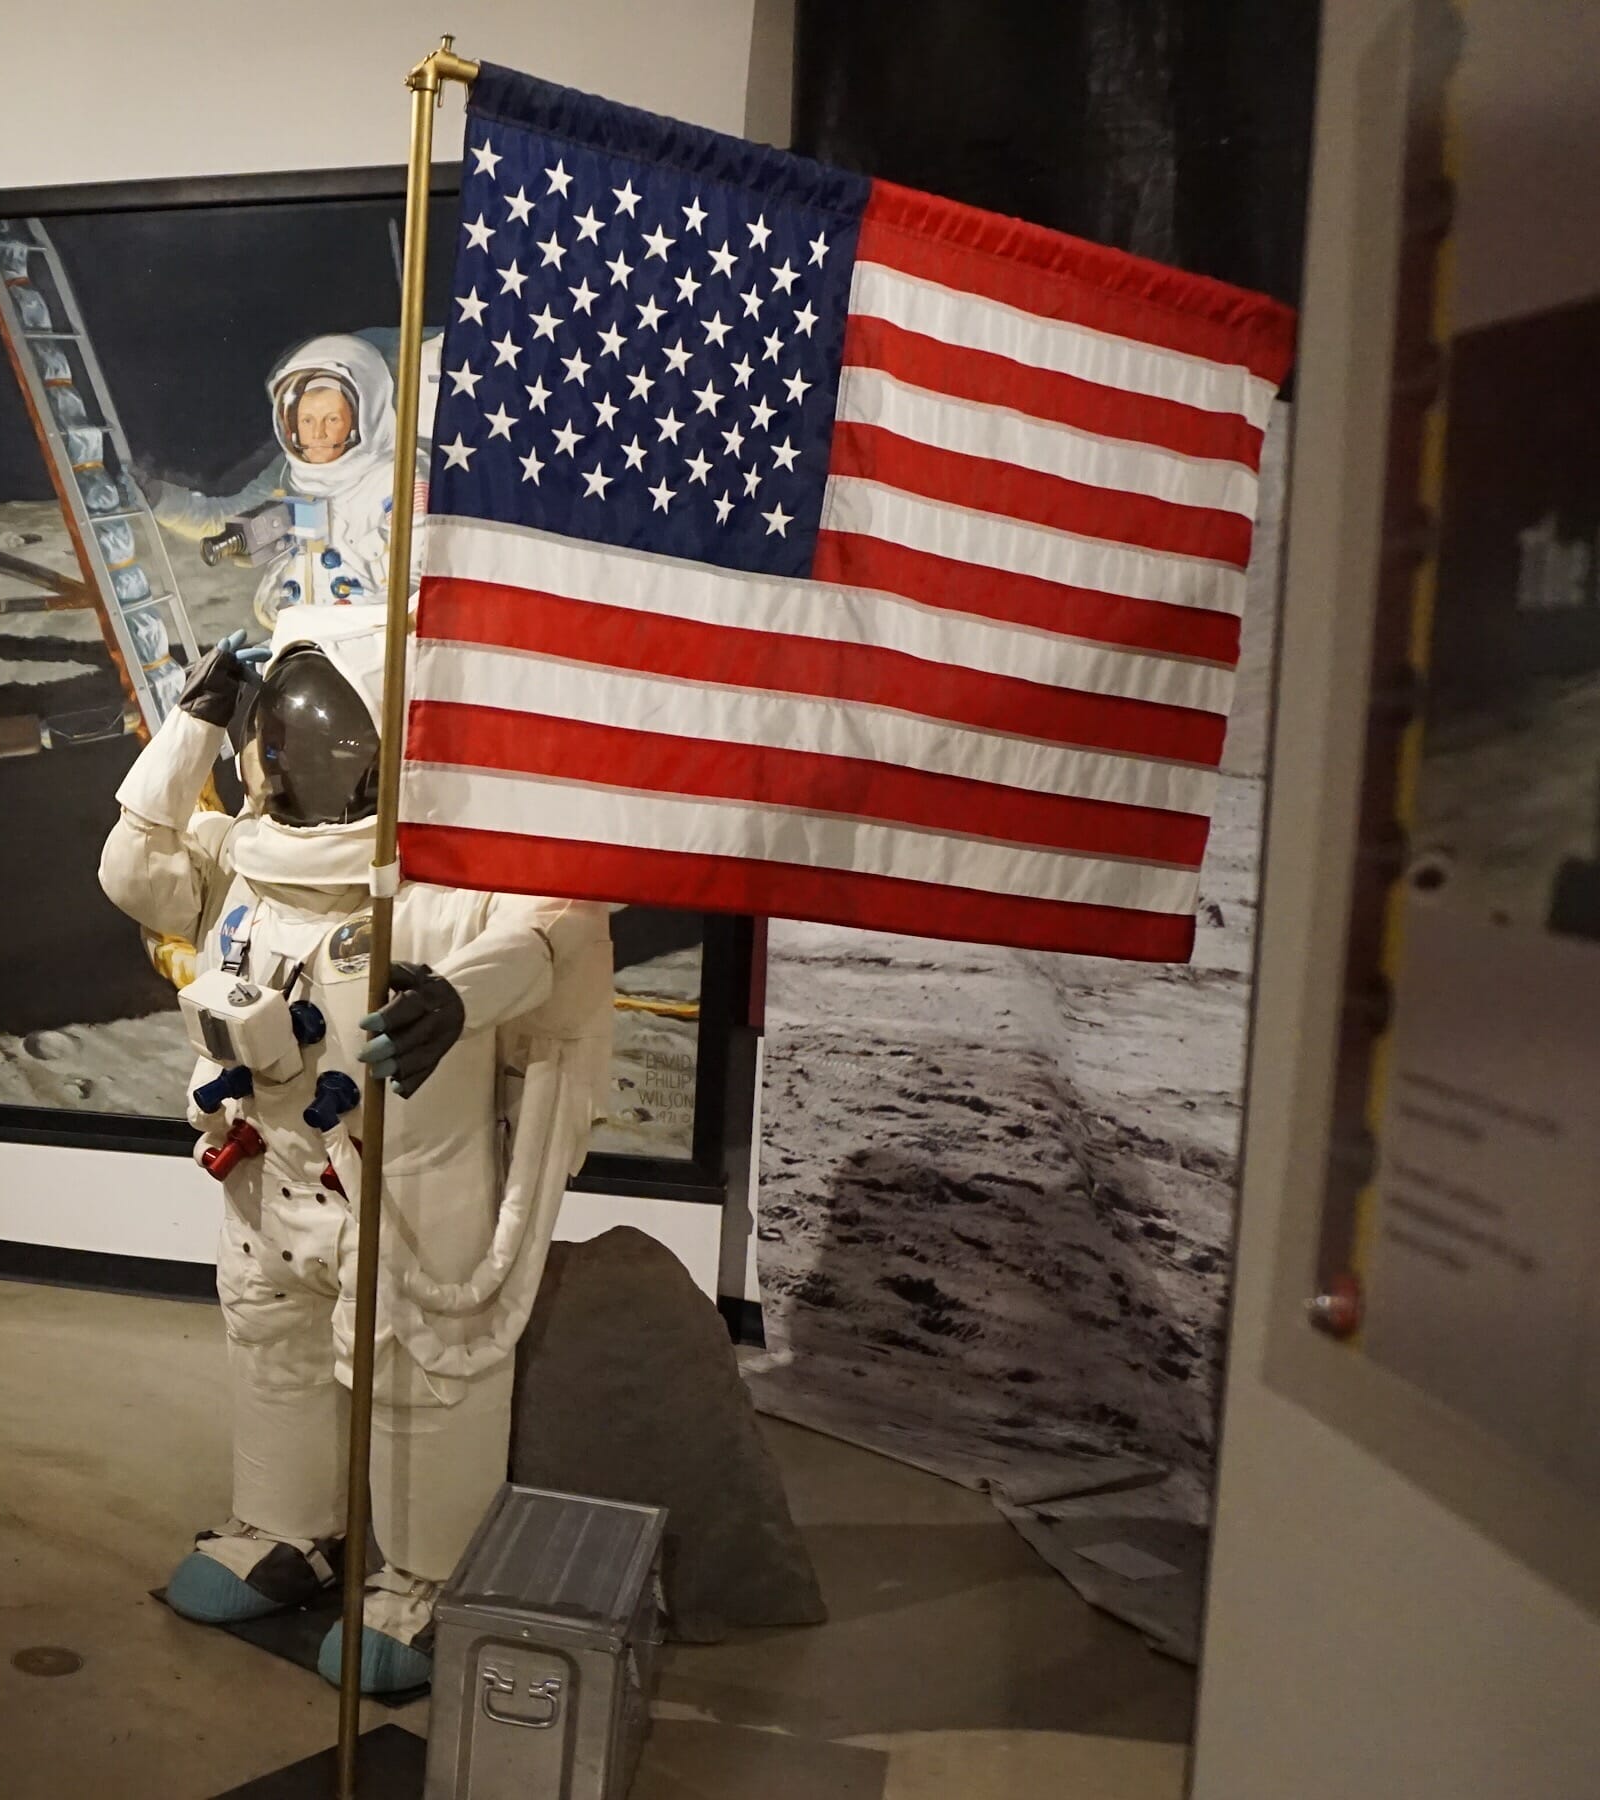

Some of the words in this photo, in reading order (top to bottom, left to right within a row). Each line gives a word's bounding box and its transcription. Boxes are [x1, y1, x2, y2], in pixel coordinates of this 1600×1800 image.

[646, 1051, 691, 1071] DAVID
[646, 1070, 692, 1088] PHILIP
[637, 1088, 694, 1110] WILSON
